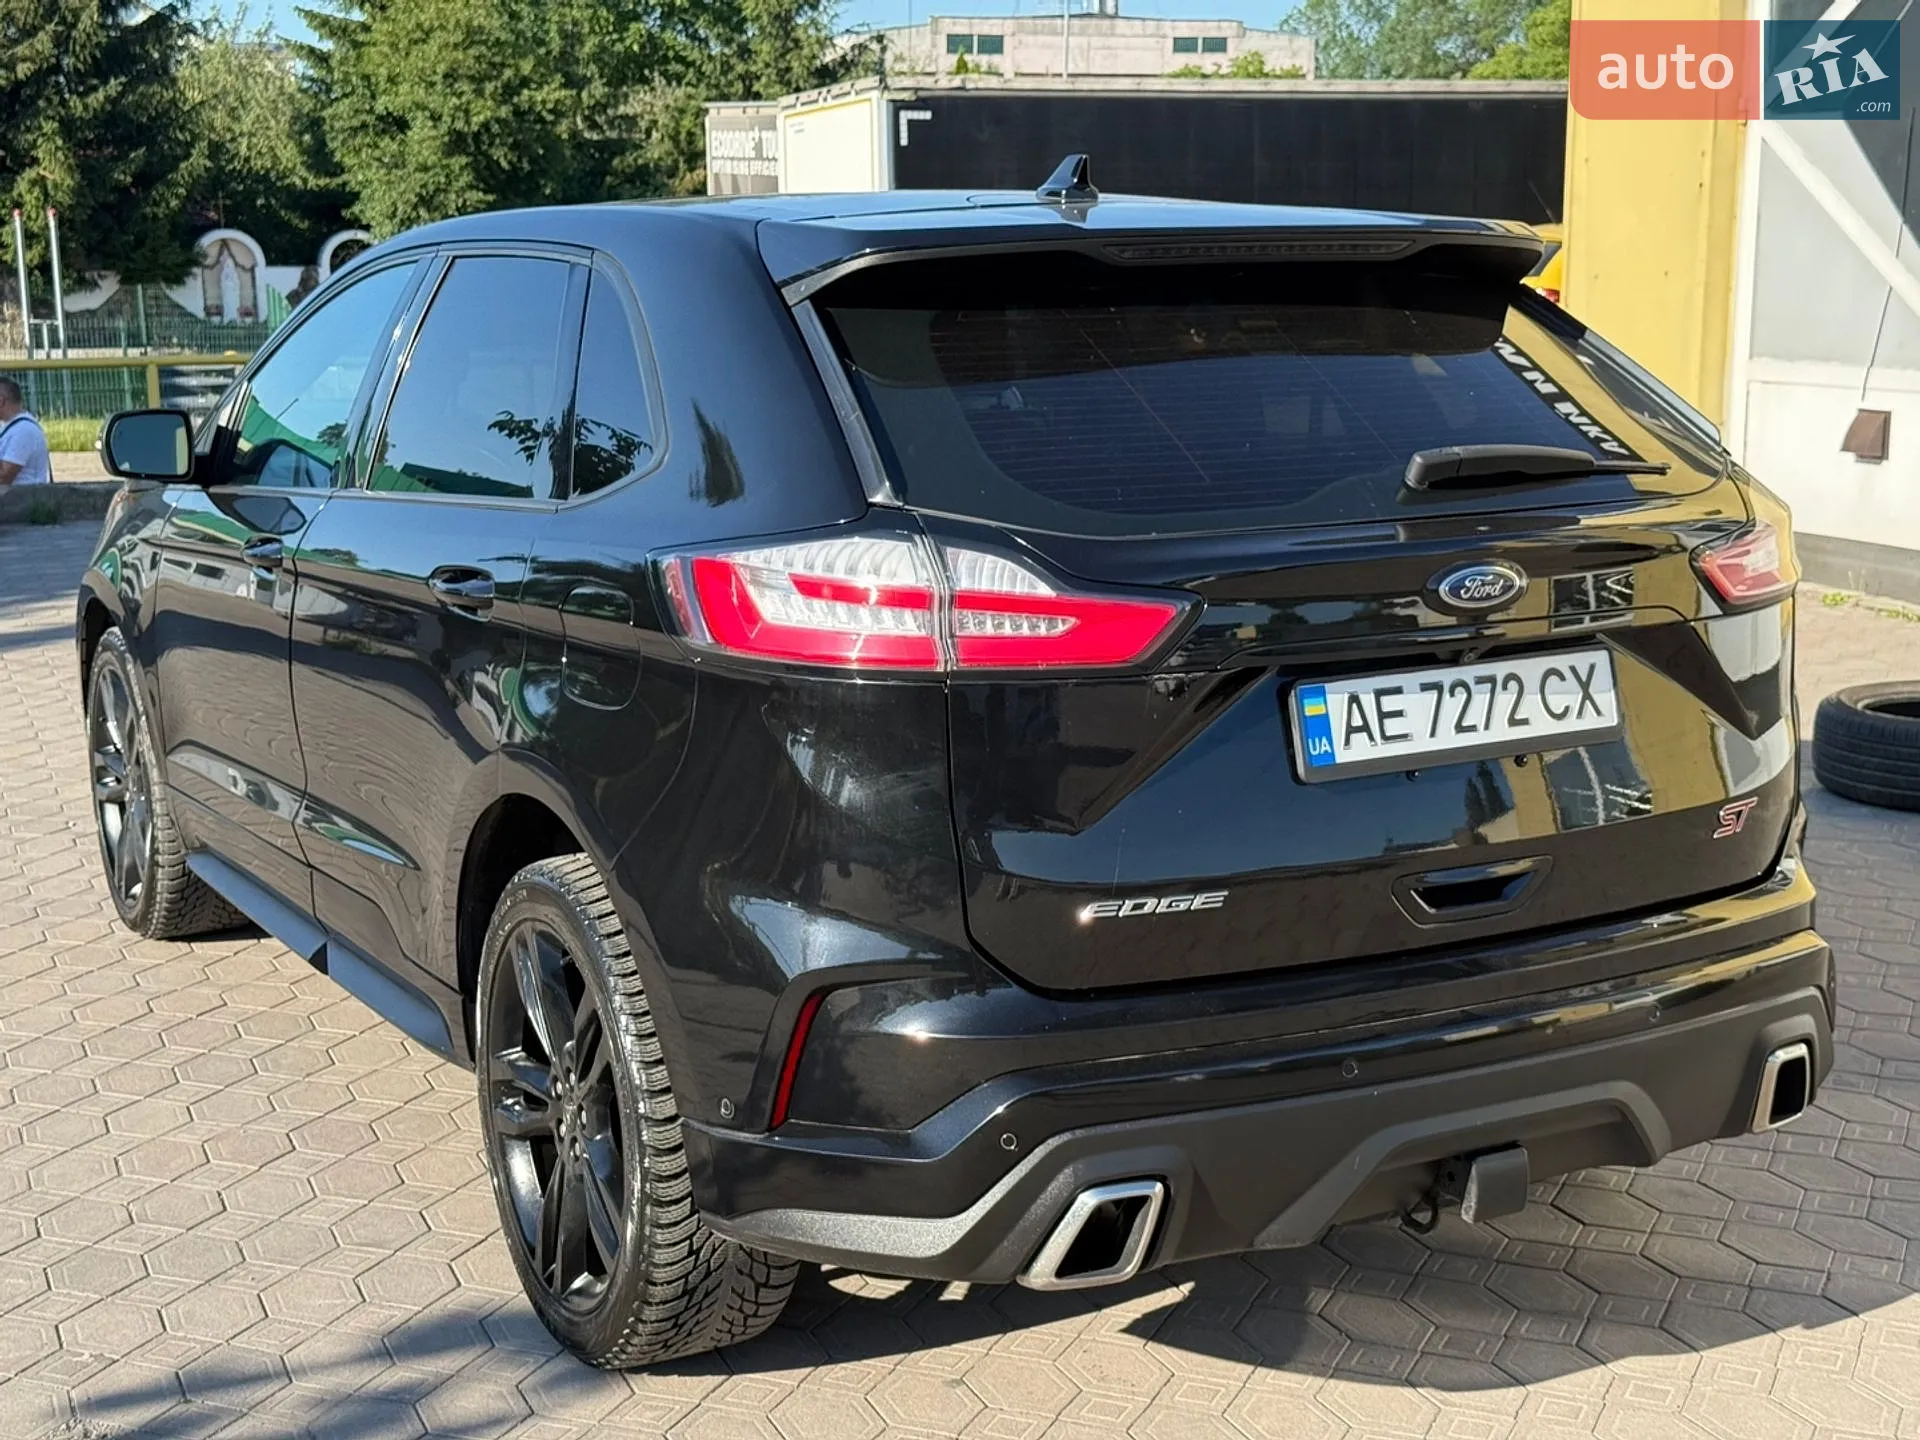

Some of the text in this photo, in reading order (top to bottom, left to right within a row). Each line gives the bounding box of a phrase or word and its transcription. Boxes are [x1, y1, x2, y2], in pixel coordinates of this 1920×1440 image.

[1460, 575, 1504, 599] Ford
[1342, 662, 1606, 750] AE 7272 CX
[1308, 737, 1332, 756] UA
[1712, 796, 1759, 839] ST
[1080, 890, 1229, 919] EDGE
